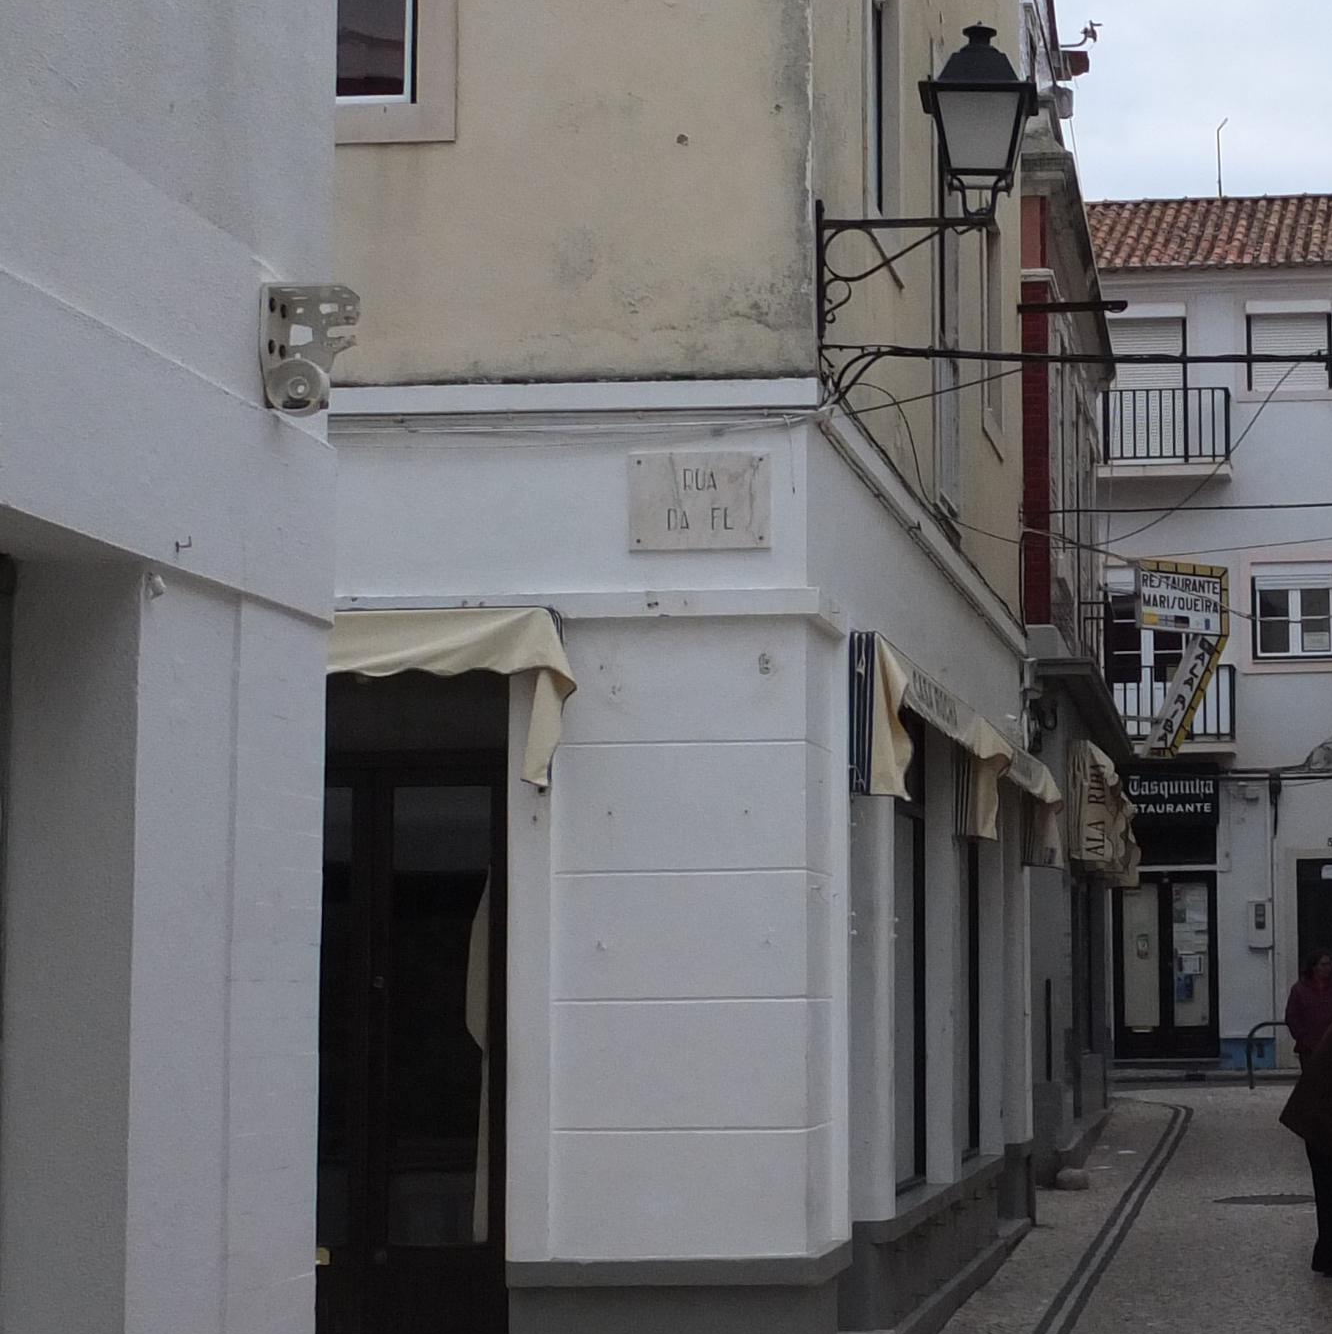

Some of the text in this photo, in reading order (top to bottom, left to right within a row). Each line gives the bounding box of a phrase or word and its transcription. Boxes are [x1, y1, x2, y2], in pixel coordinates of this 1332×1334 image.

[683, 468, 717, 491] RUA
[667, 508, 690, 531] DA
[1142, 573, 1220, 595] RESTAURANTE
[1142, 593, 1219, 614] MARISQUEIRA
[1157, 694, 1186, 748] RIBA
[1128, 775, 1215, 799] Tasquinha
[1085, 764, 1106, 857] ALA RIBA
